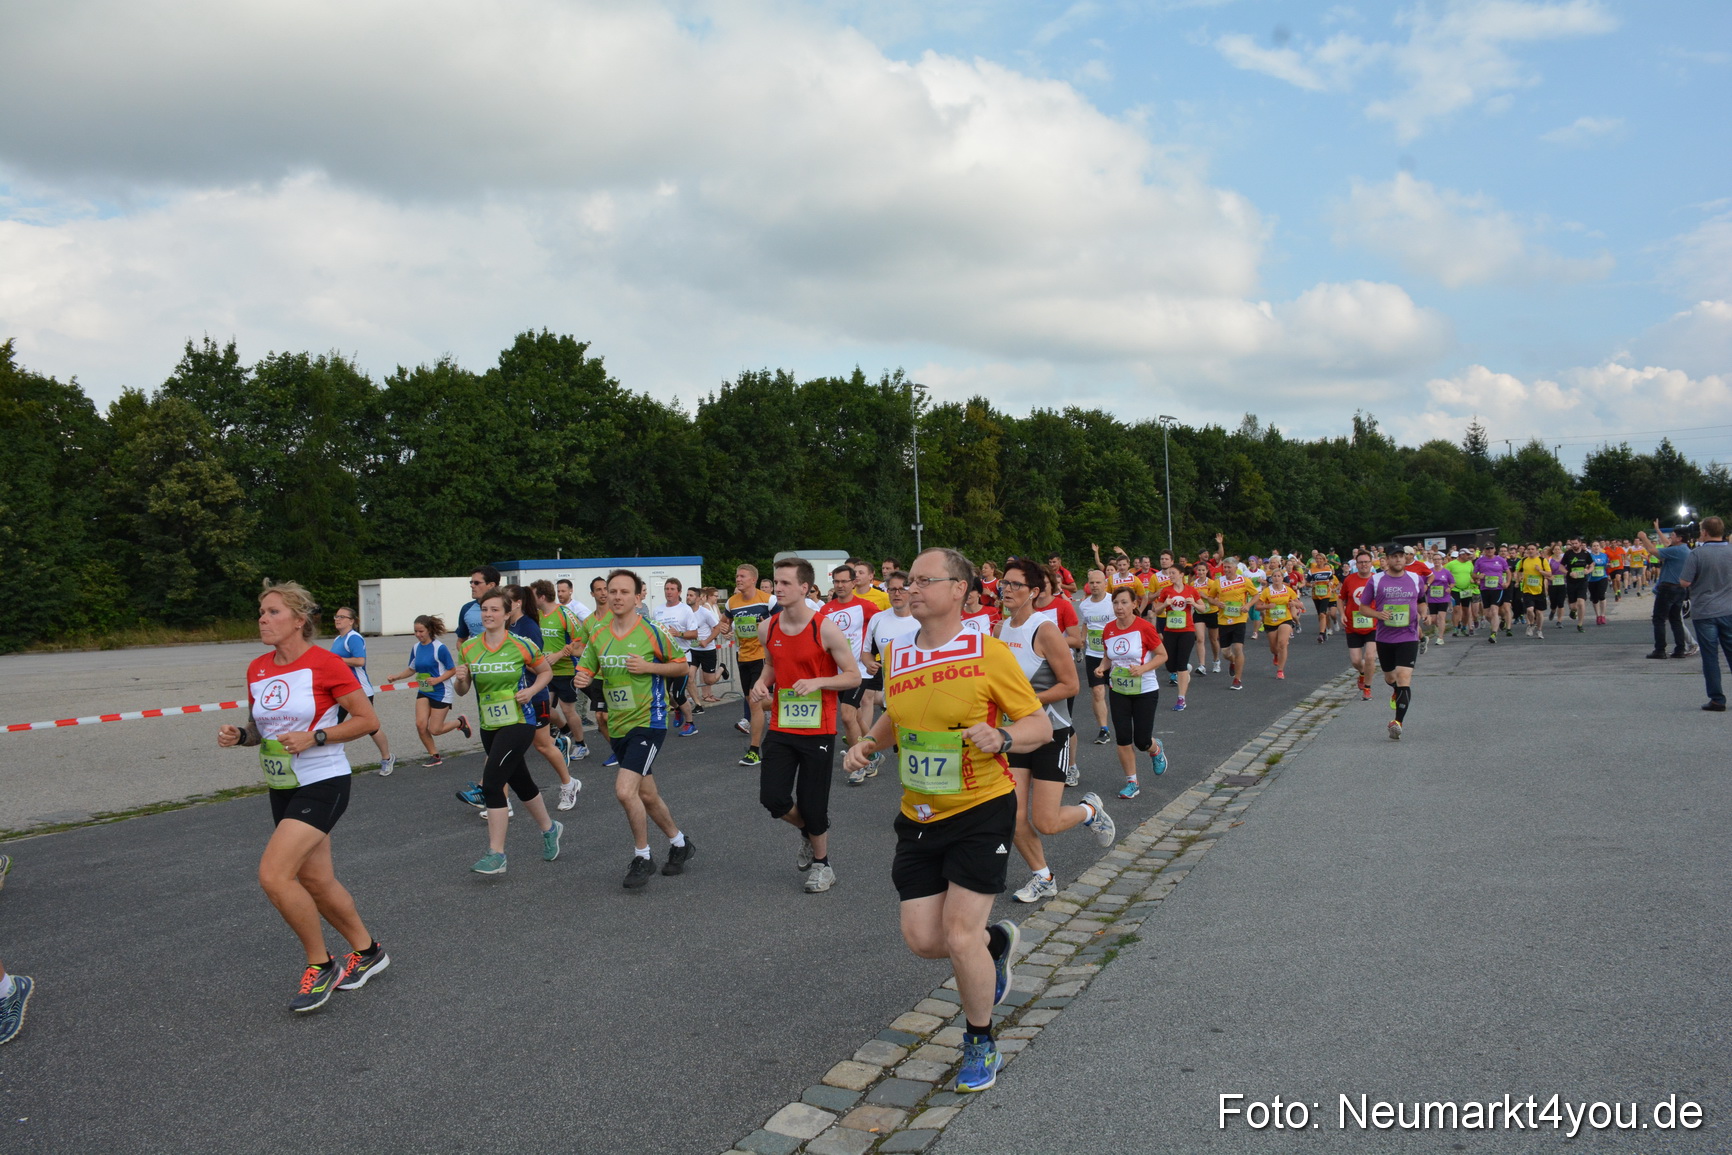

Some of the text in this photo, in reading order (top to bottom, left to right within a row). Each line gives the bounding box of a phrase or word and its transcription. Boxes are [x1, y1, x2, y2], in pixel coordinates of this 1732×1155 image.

[1172, 600, 1185, 608] 48
[1357, 617, 1369, 625] 501
[737, 624, 757, 633] 1642
[470, 662, 516, 674] BOCK
[889, 665, 985, 698] MAX BÖGL
[1117, 677, 1134, 688] 541
[607, 689, 628, 702] 152
[487, 704, 509, 718] 151
[783, 704, 818, 717] 1397
[263, 758, 287, 776] 532
[908, 754, 947, 777] 917
